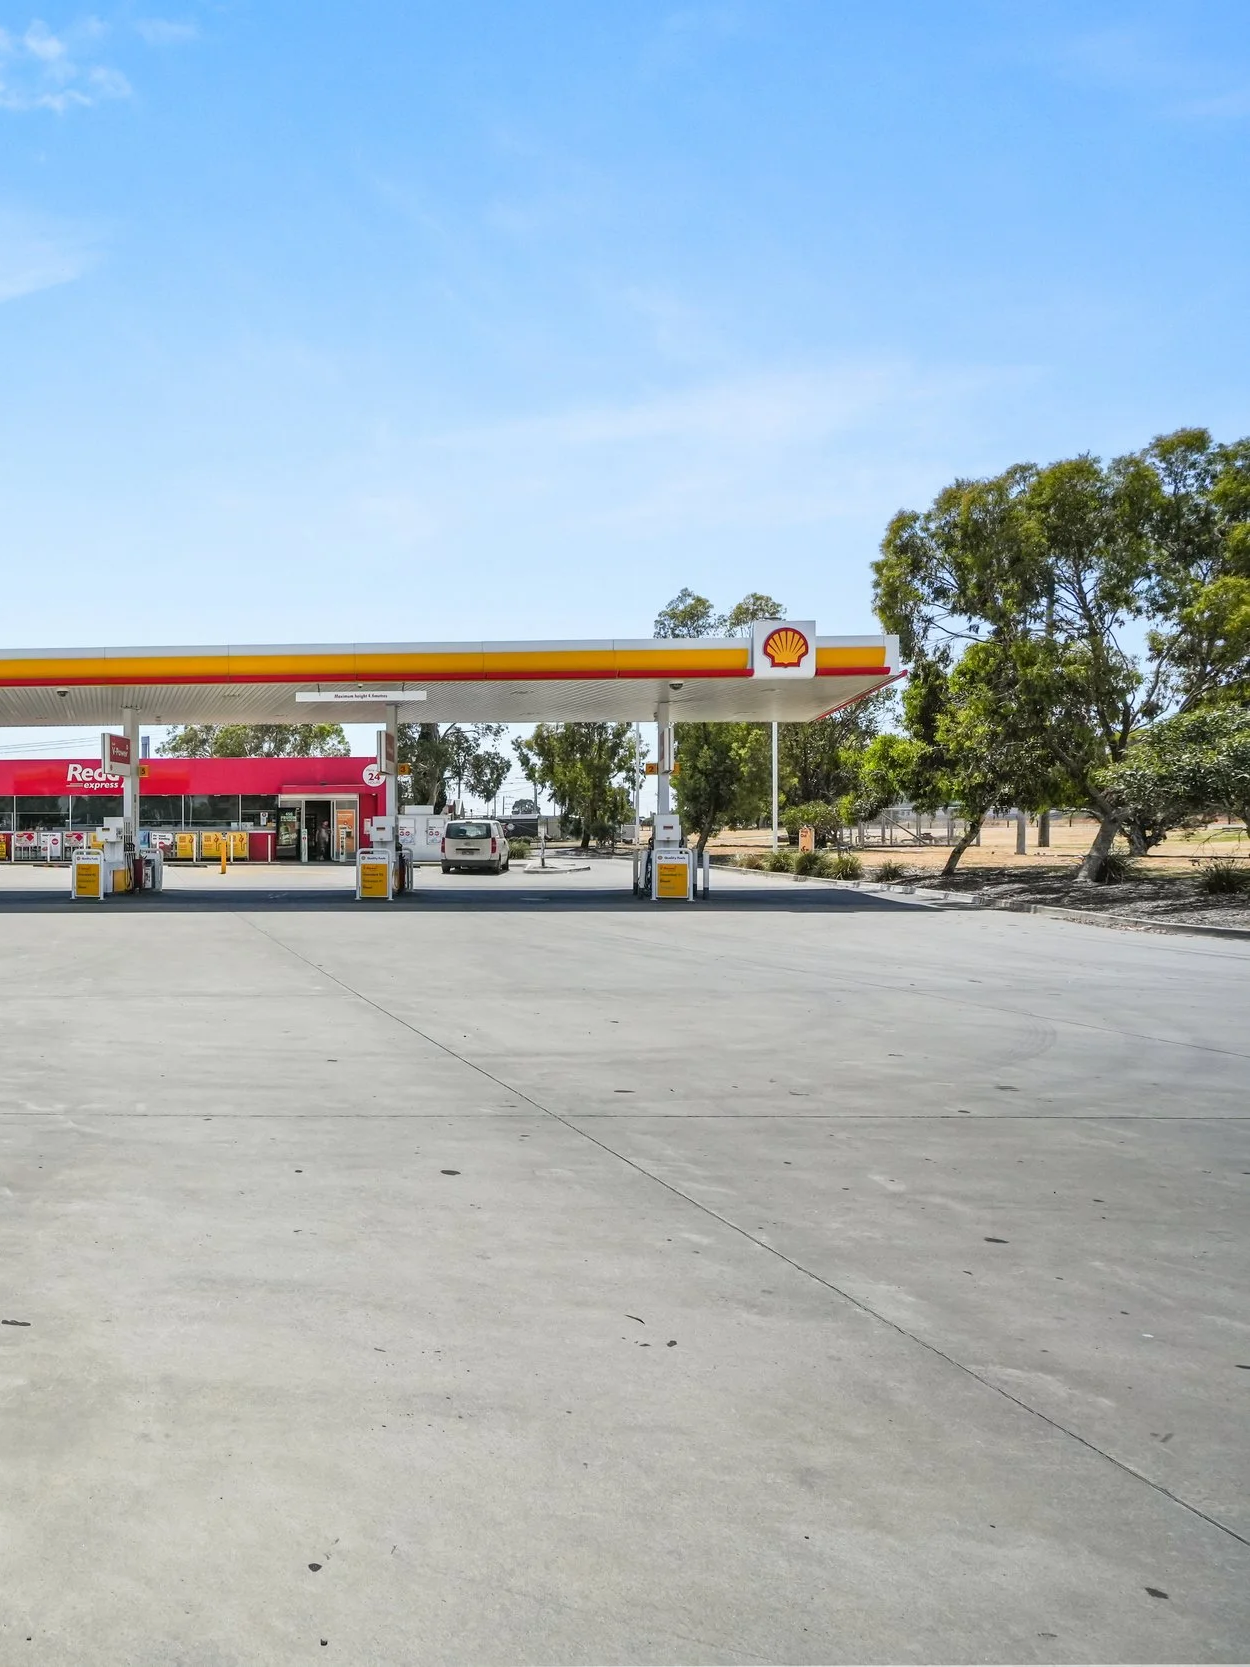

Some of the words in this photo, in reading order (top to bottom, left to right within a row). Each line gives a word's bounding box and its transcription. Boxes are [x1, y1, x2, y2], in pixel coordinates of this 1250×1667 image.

[111, 746, 129, 757] V-Power
[648, 765, 654, 773] 2
[368, 773, 380, 781] 24
[83, 782, 119, 790] express
